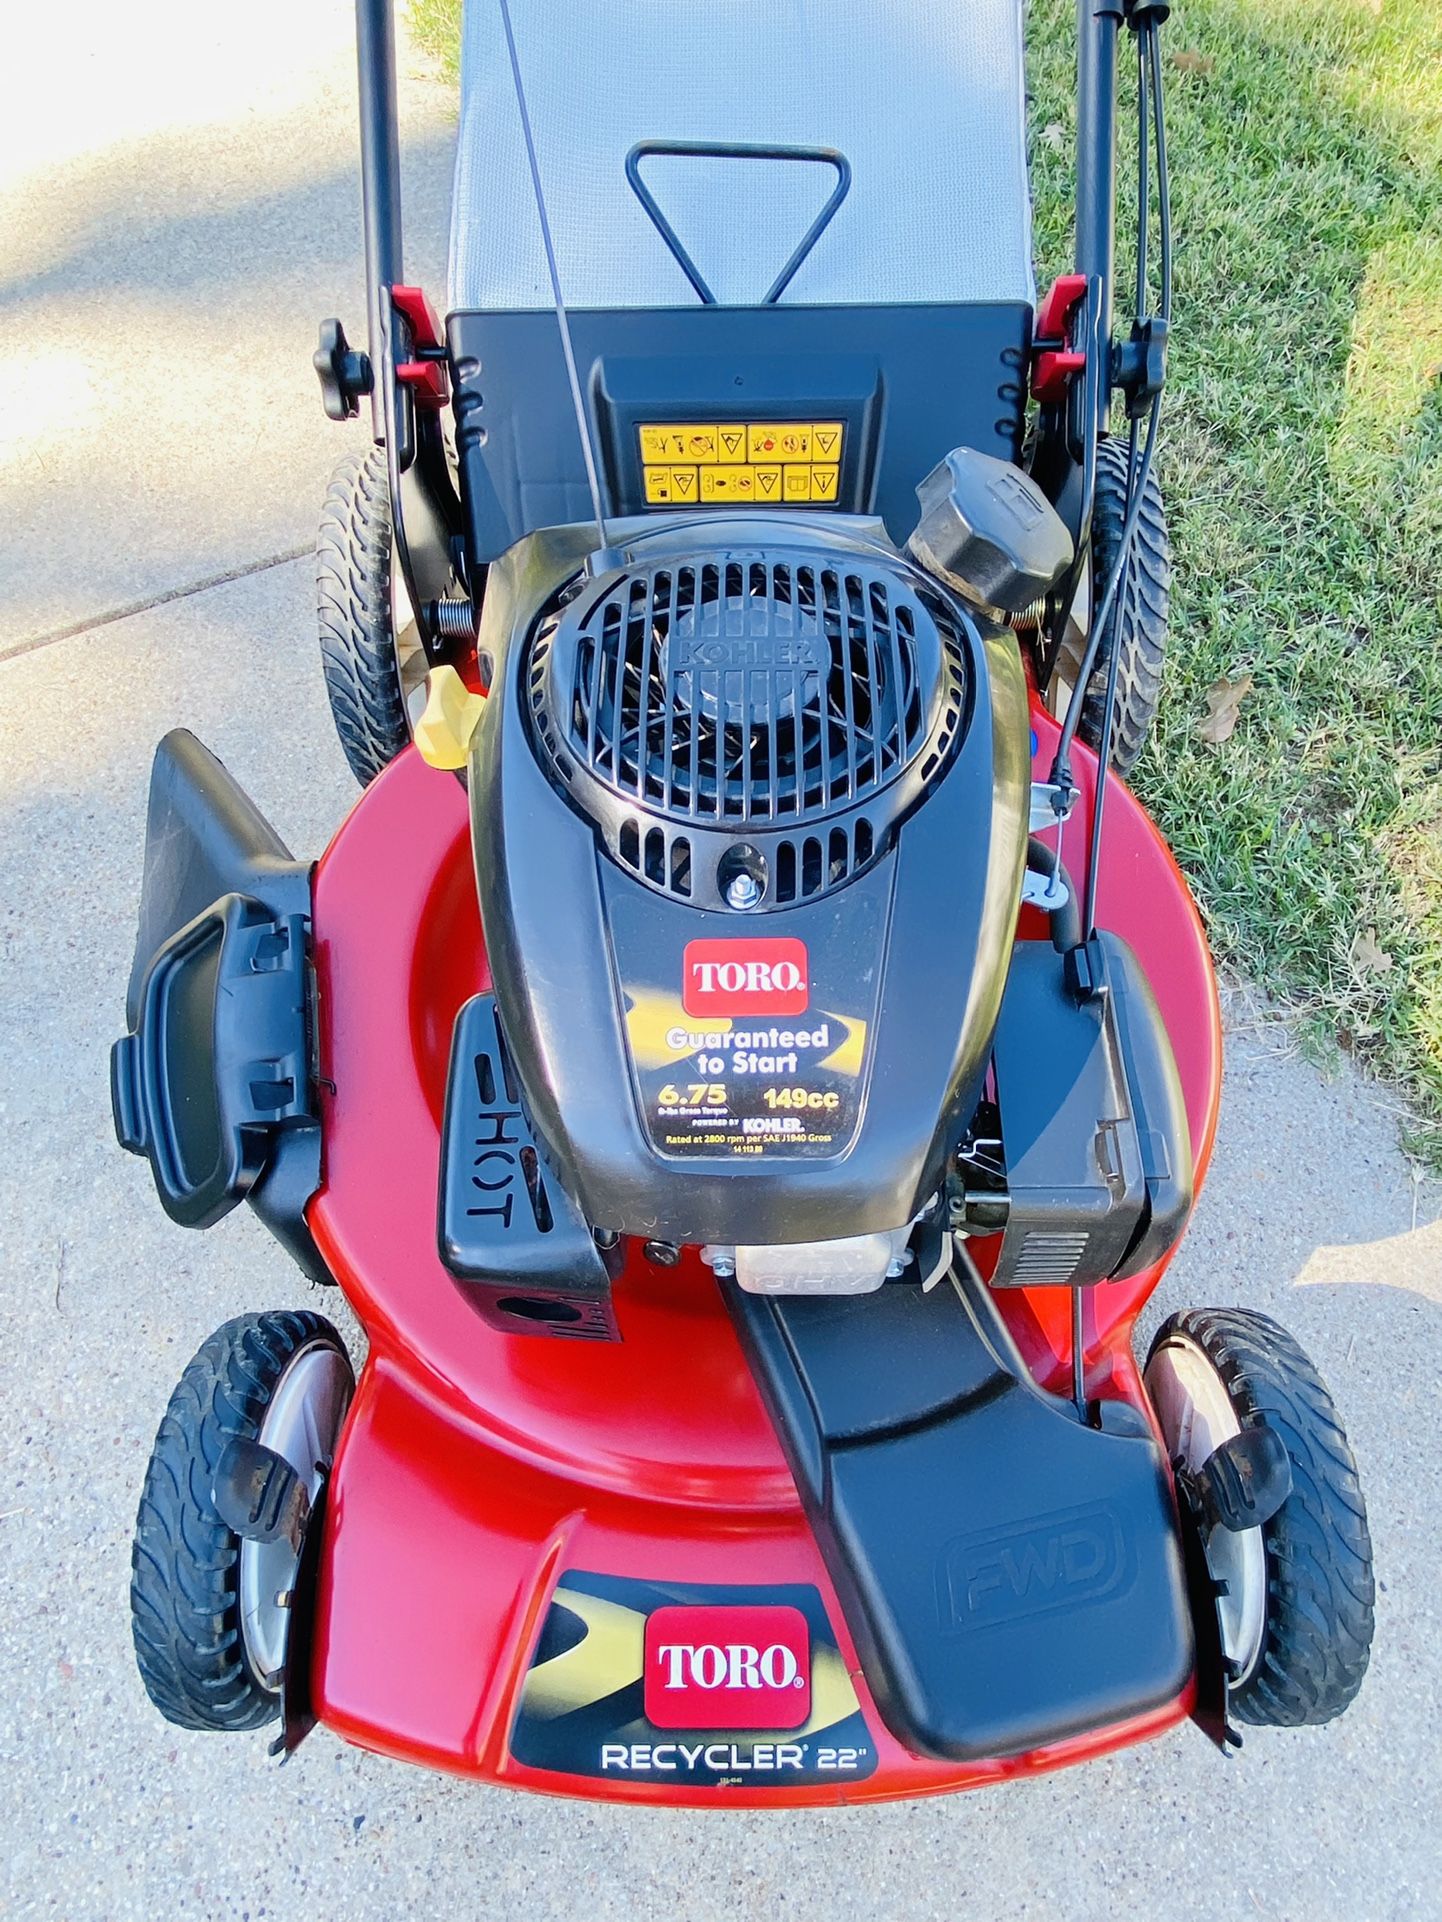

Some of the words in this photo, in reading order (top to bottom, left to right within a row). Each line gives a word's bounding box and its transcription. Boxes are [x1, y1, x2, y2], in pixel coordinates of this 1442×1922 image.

[693, 961, 801, 992] TORO
[666, 1024, 829, 1050] Guaranteed
[698, 1053, 725, 1075] to
[732, 1051, 798, 1074] Start
[657, 1083, 727, 1105] 6.75
[763, 1087, 839, 1109] 149cc
[692, 1118, 728, 1126] POWERED
[729, 1118, 739, 1126] BY
[702, 1106, 728, 1119] Torque
[665, 1135, 692, 1144] Rated
[693, 1136, 703, 1144] at
[704, 1135, 726, 1143] 2800
[727, 1135, 745, 1145] rpm
[746, 1135, 762, 1145] per
[763, 1133, 780, 1142] SAE
[781, 1133, 806, 1142] J1940
[807, 1133, 832, 1142] Gross
[466, 1111, 522, 1229] HOT
[966, 1530, 1107, 1612] FWD
[658, 1644, 798, 1689] TORO
[602, 1744, 804, 1770] RECYCLER
[816, 1747, 867, 1769] 22"
